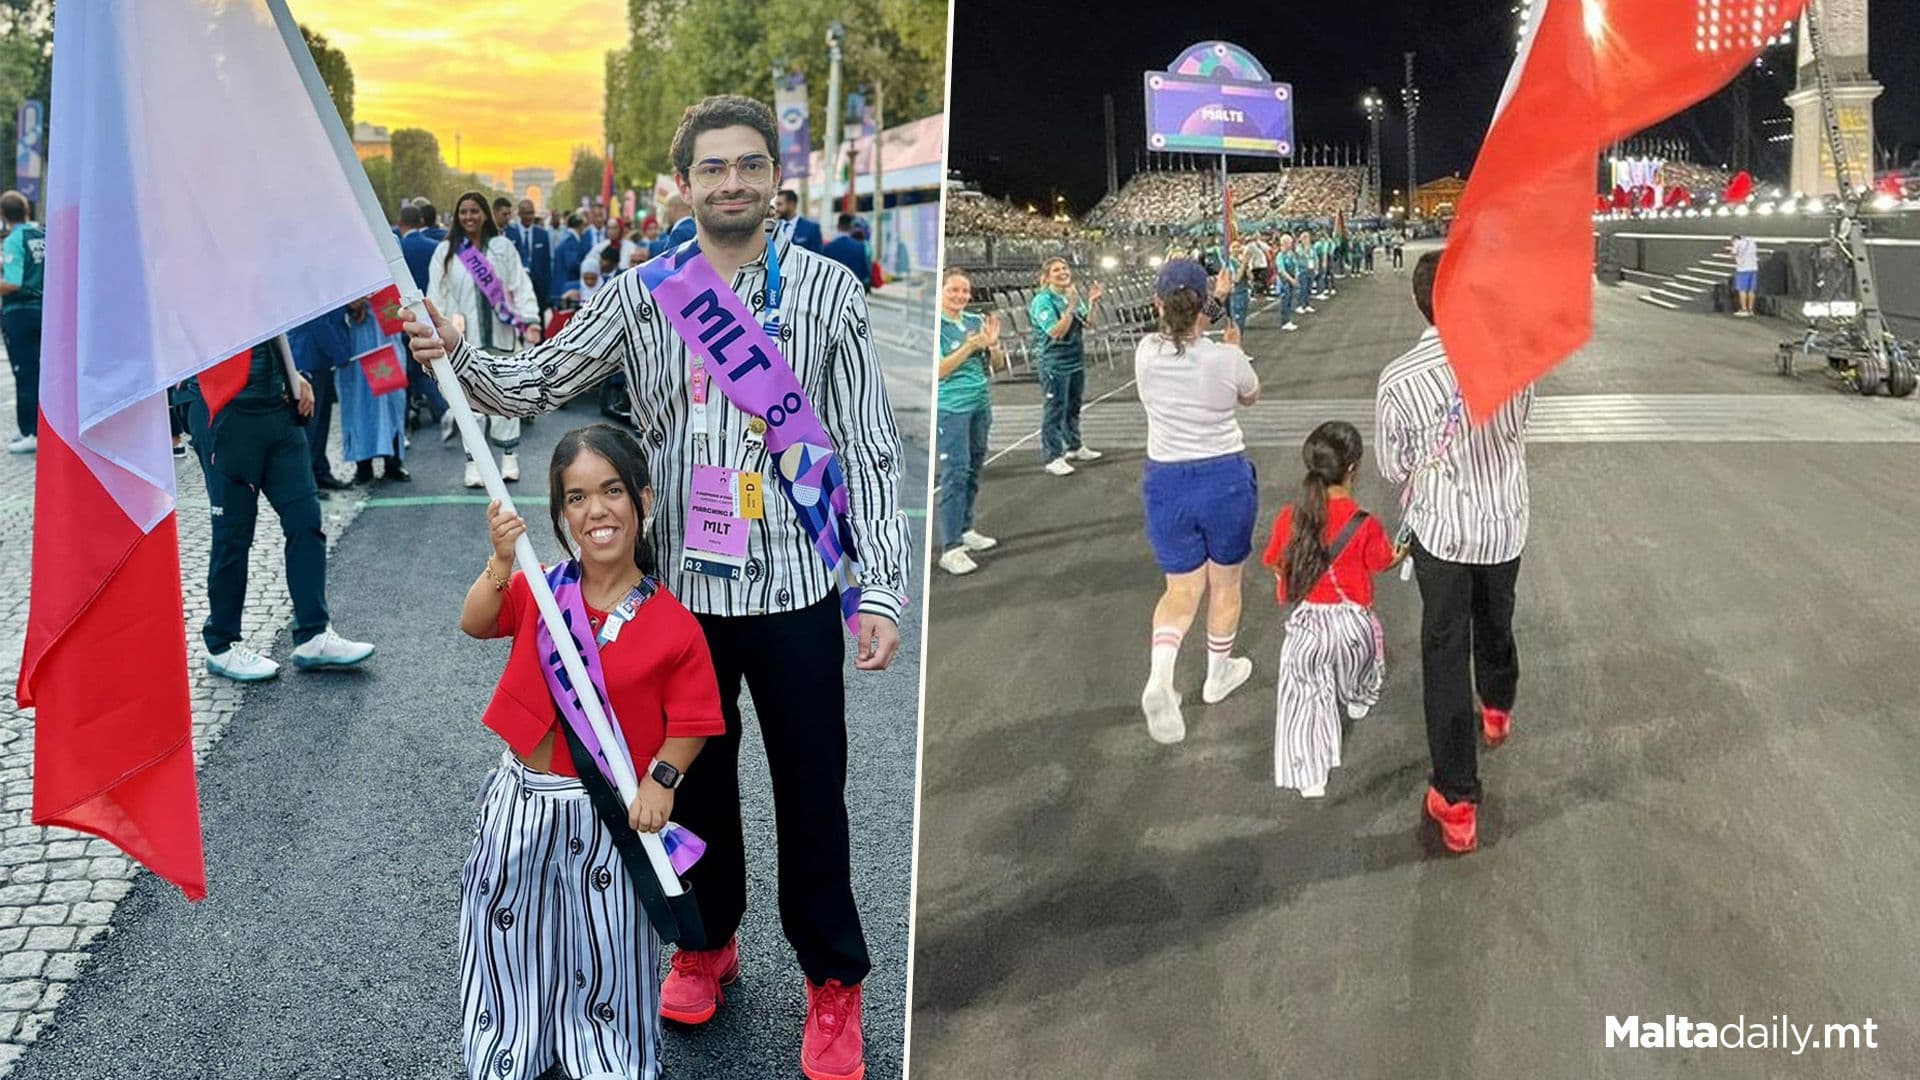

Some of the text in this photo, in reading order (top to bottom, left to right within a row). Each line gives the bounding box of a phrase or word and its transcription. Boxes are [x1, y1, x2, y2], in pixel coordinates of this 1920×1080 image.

[1201, 109, 1244, 123] MALTE
[466, 255, 494, 288] MAR
[680, 288, 772, 382] MLT
[703, 520, 731, 536] MLT
